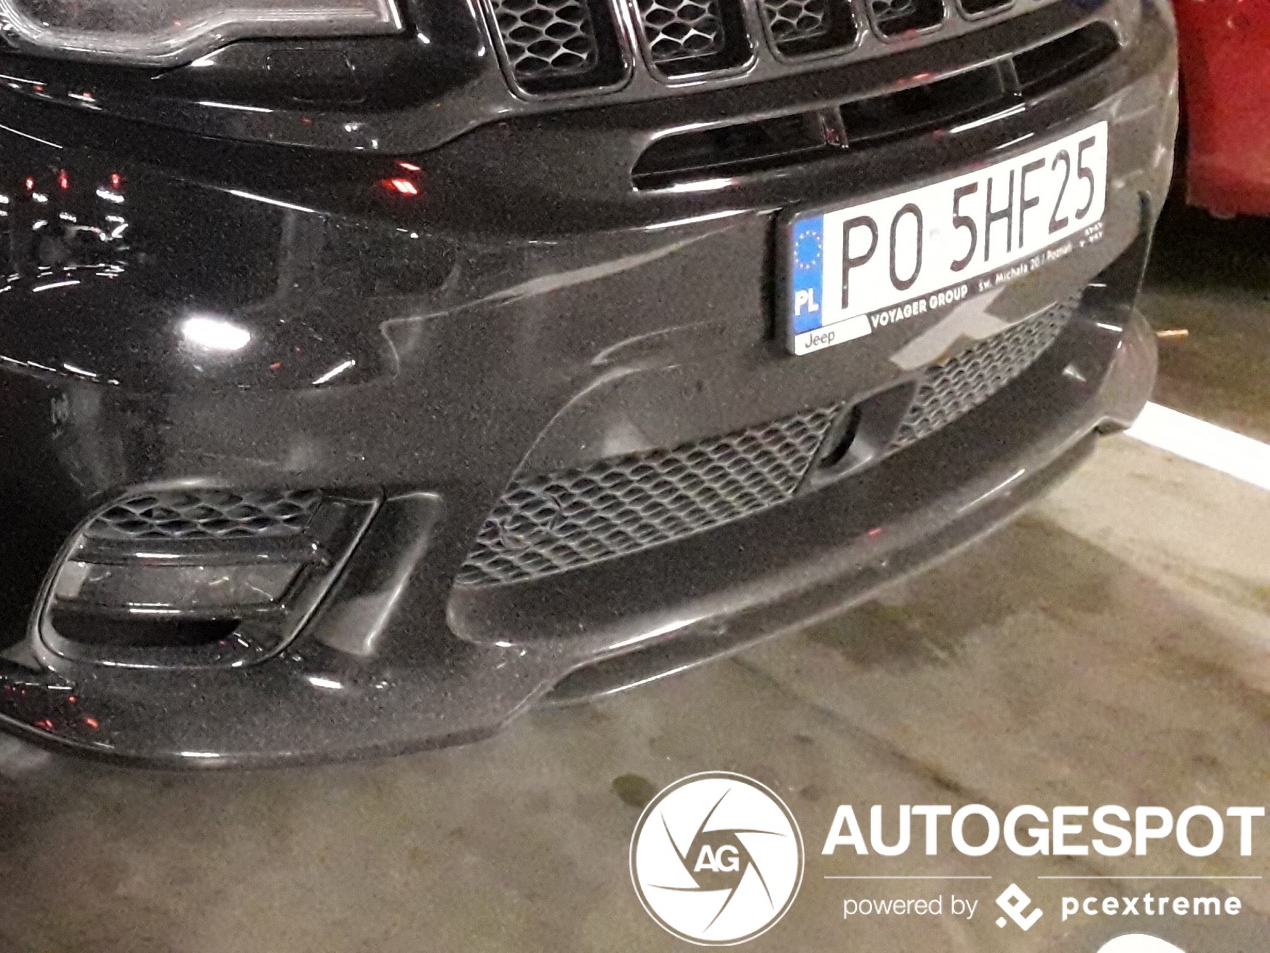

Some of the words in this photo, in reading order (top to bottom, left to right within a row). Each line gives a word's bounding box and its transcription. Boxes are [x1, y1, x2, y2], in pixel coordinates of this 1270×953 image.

[841, 203, 923, 309] PO
[950, 135, 1097, 272] 5HF25
[794, 287, 819, 316] PL
[871, 299, 927, 328] VOYAGER
[929, 284, 968, 309] GROUP
[804, 331, 835, 349] Jeep
